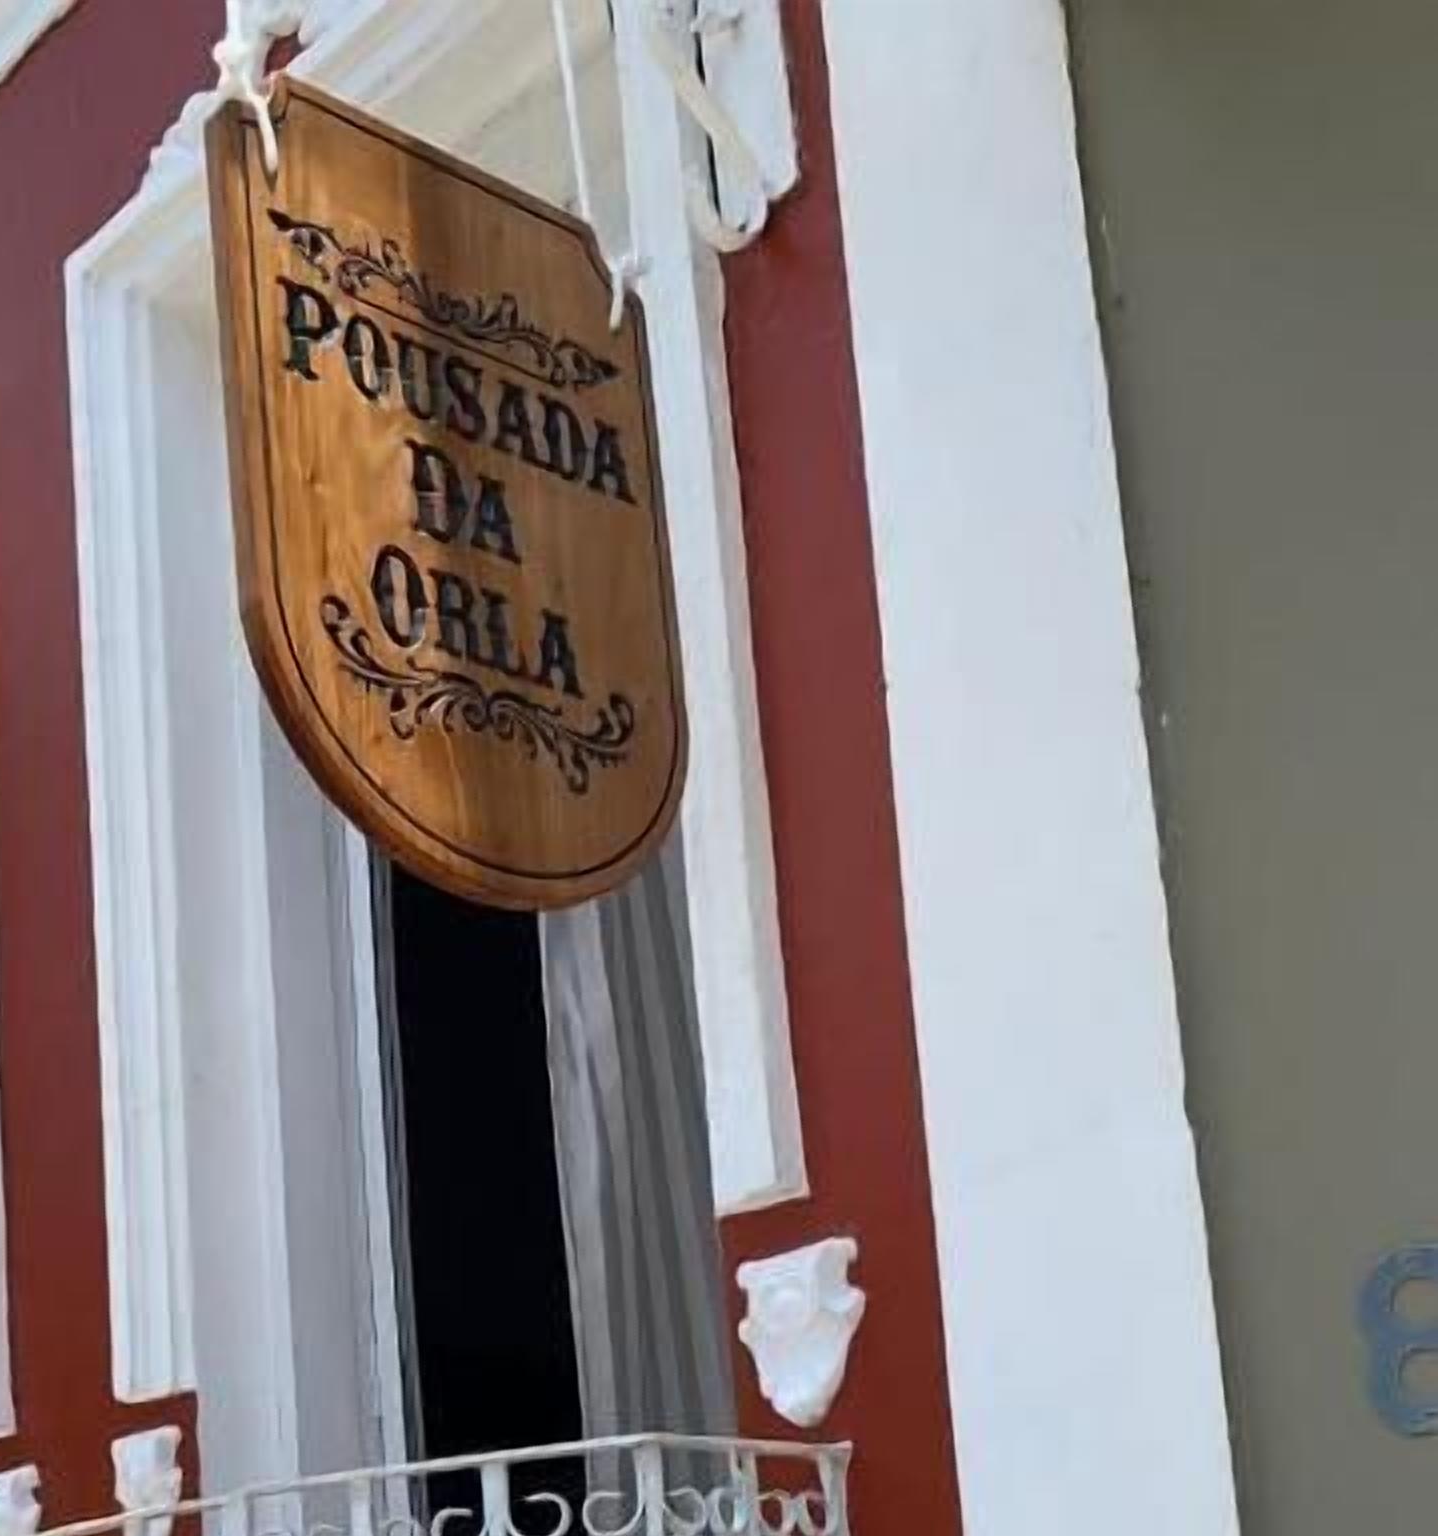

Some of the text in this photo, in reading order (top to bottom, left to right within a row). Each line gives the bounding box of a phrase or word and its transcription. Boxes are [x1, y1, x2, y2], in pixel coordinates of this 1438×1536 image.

[275, 276, 637, 504] POUSADA
[405, 437, 522, 564] DA
[369, 544, 584, 700] ORLA
